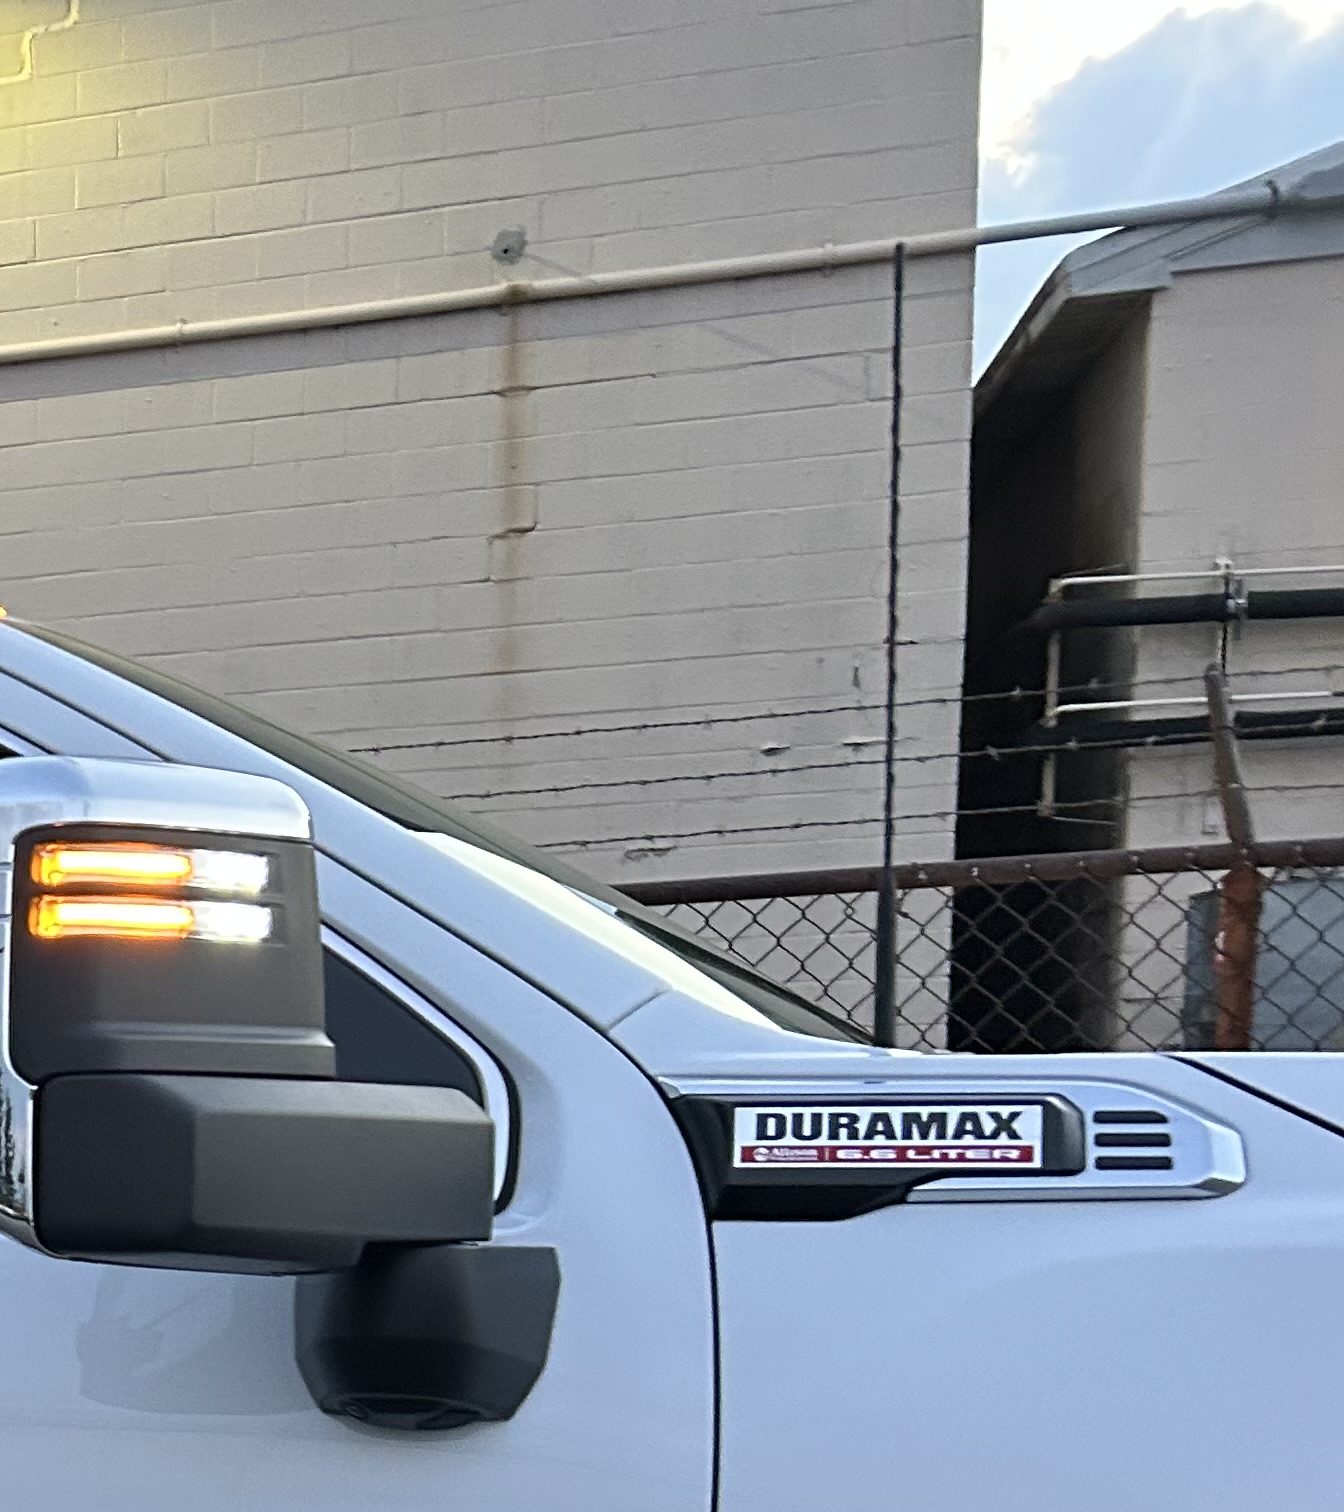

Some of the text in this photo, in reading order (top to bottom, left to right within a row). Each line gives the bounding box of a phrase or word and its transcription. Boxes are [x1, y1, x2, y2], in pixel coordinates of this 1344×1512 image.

[754, 1110, 1024, 1141] DURAMAX
[835, 1147, 1022, 1161] 6.6 LITER
